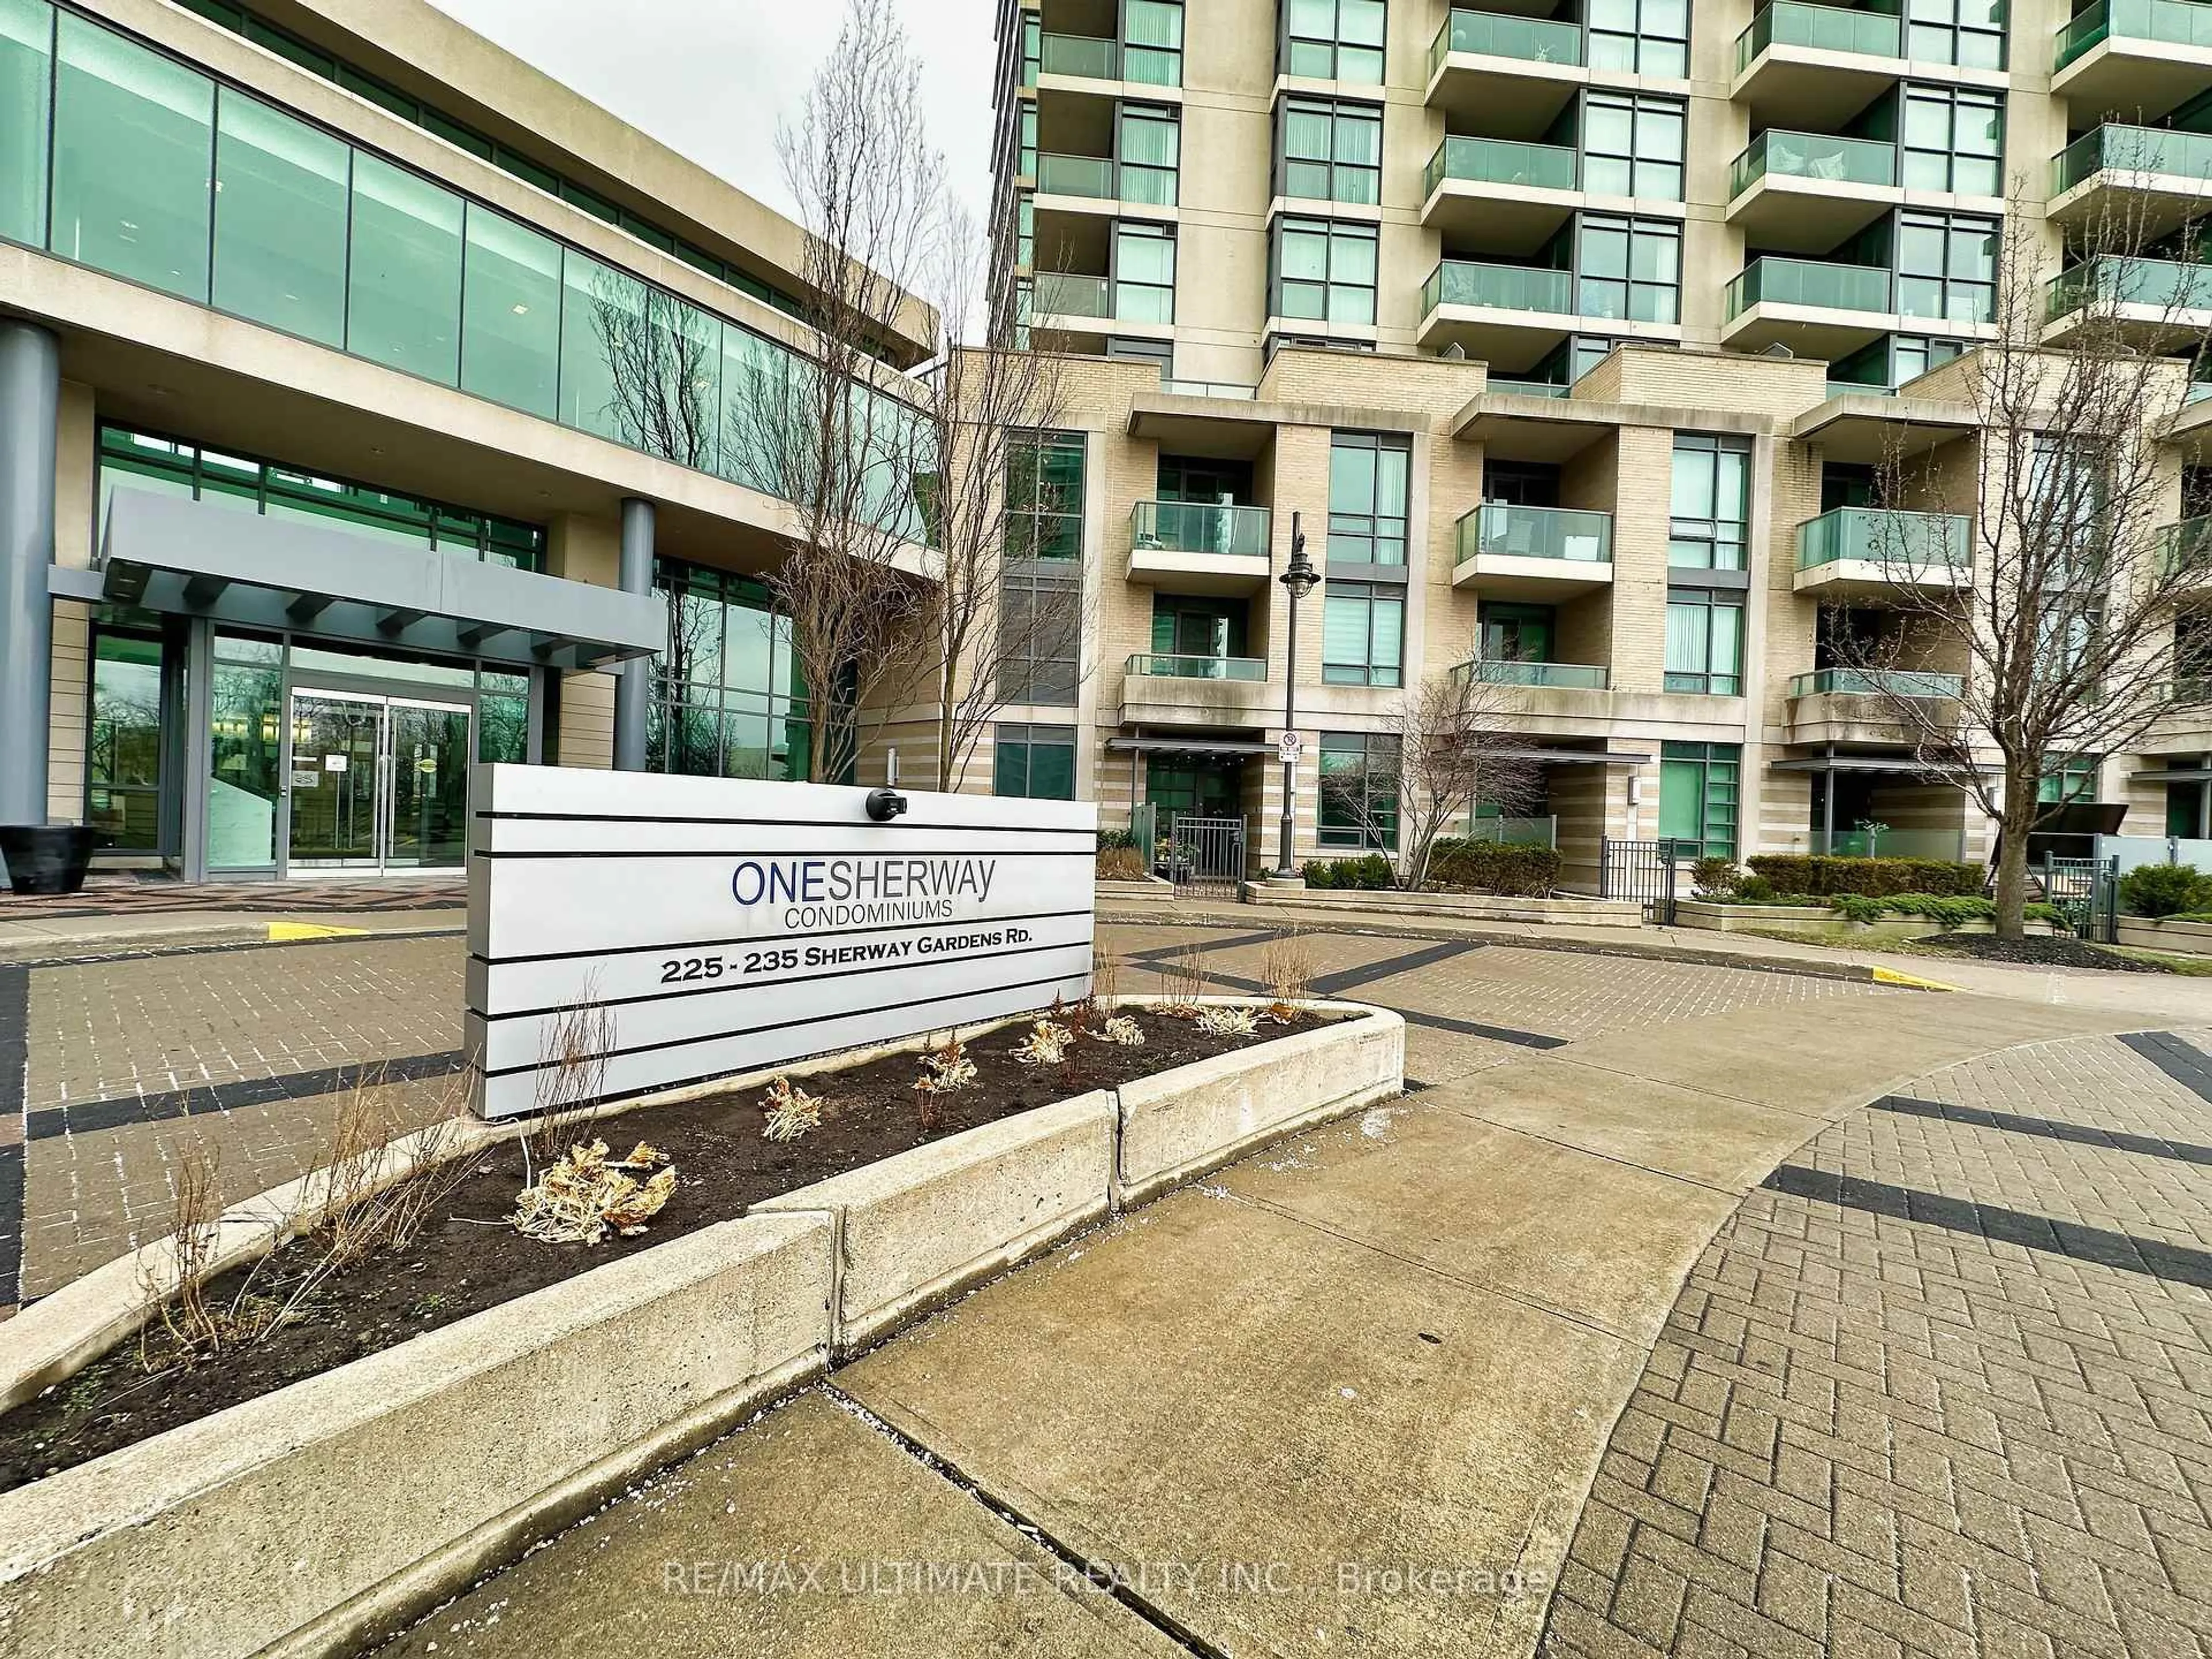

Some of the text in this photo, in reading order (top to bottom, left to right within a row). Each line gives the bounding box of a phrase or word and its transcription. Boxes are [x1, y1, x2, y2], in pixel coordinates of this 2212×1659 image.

[784, 899, 953, 929] CONDOMINIUMS
[660, 956, 724, 984] 225
[743, 947, 798, 975] 235
[804, 940, 913, 967] SHERWAY
[916, 931, 1002, 954] GARDENS
[1005, 928, 1033, 944] RD.
